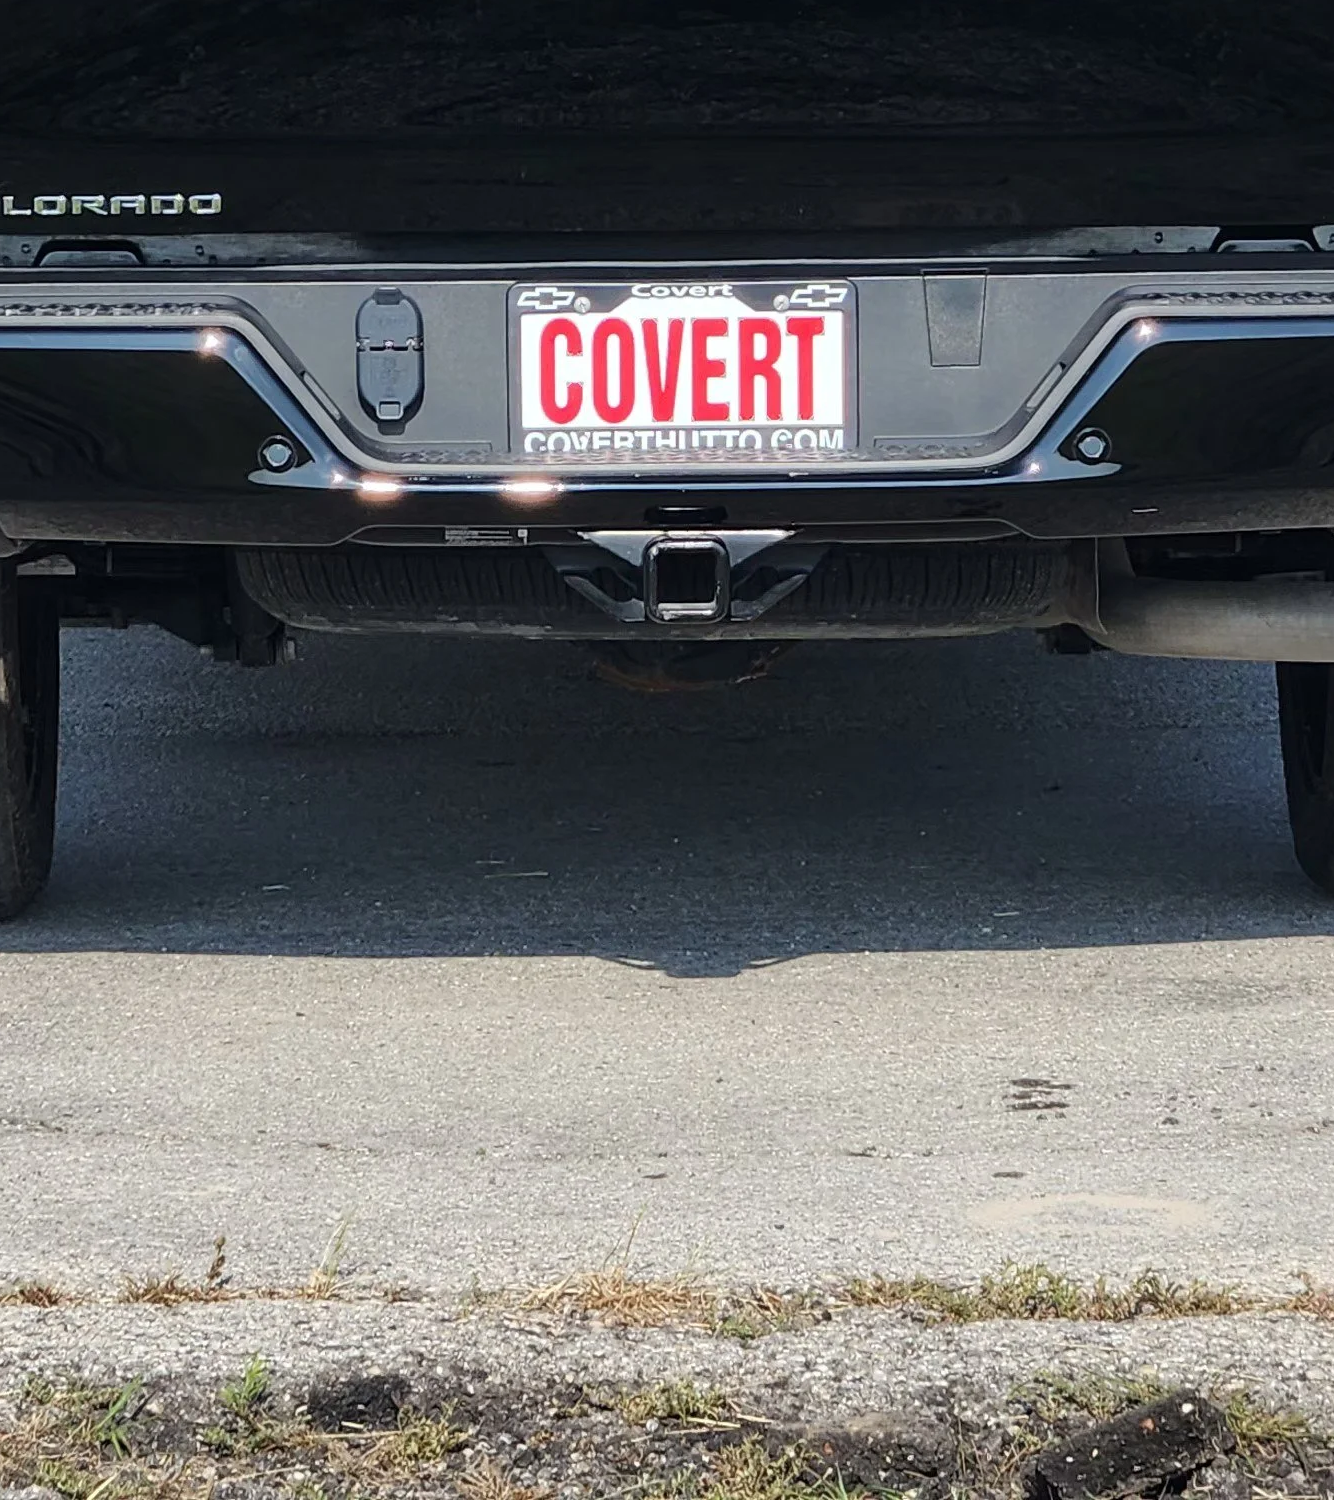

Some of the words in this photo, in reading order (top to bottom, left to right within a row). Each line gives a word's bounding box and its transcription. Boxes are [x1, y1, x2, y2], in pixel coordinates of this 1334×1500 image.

[631, 284, 734, 299] Covert
[540, 317, 825, 424] COVERT
[524, 429, 844, 451] COVERTHUTTOCOM
